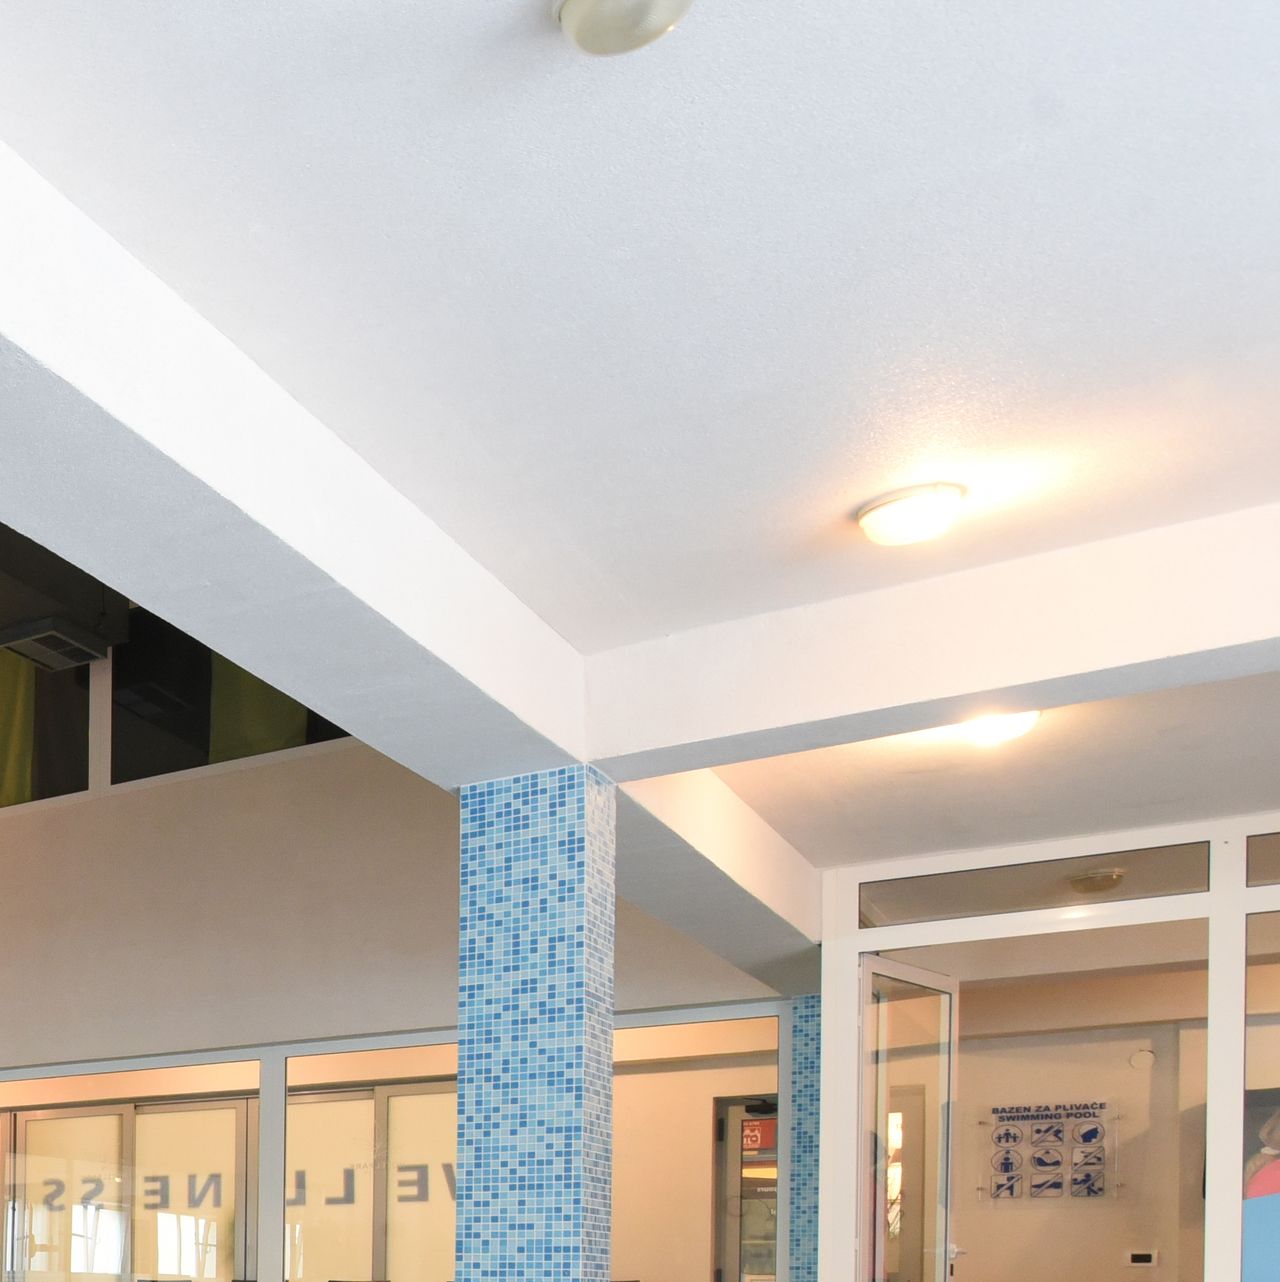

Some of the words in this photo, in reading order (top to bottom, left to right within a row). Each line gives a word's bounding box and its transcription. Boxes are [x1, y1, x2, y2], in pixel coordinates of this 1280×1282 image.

[992, 1106, 1031, 1114] BAZEN
[1034, 1105, 1051, 1113] ZA
[1055, 1102, 1106, 1111] PLIVAČE
[998, 1113, 1062, 1122] SWIMMING
[1066, 1111, 1100, 1119] POOL
